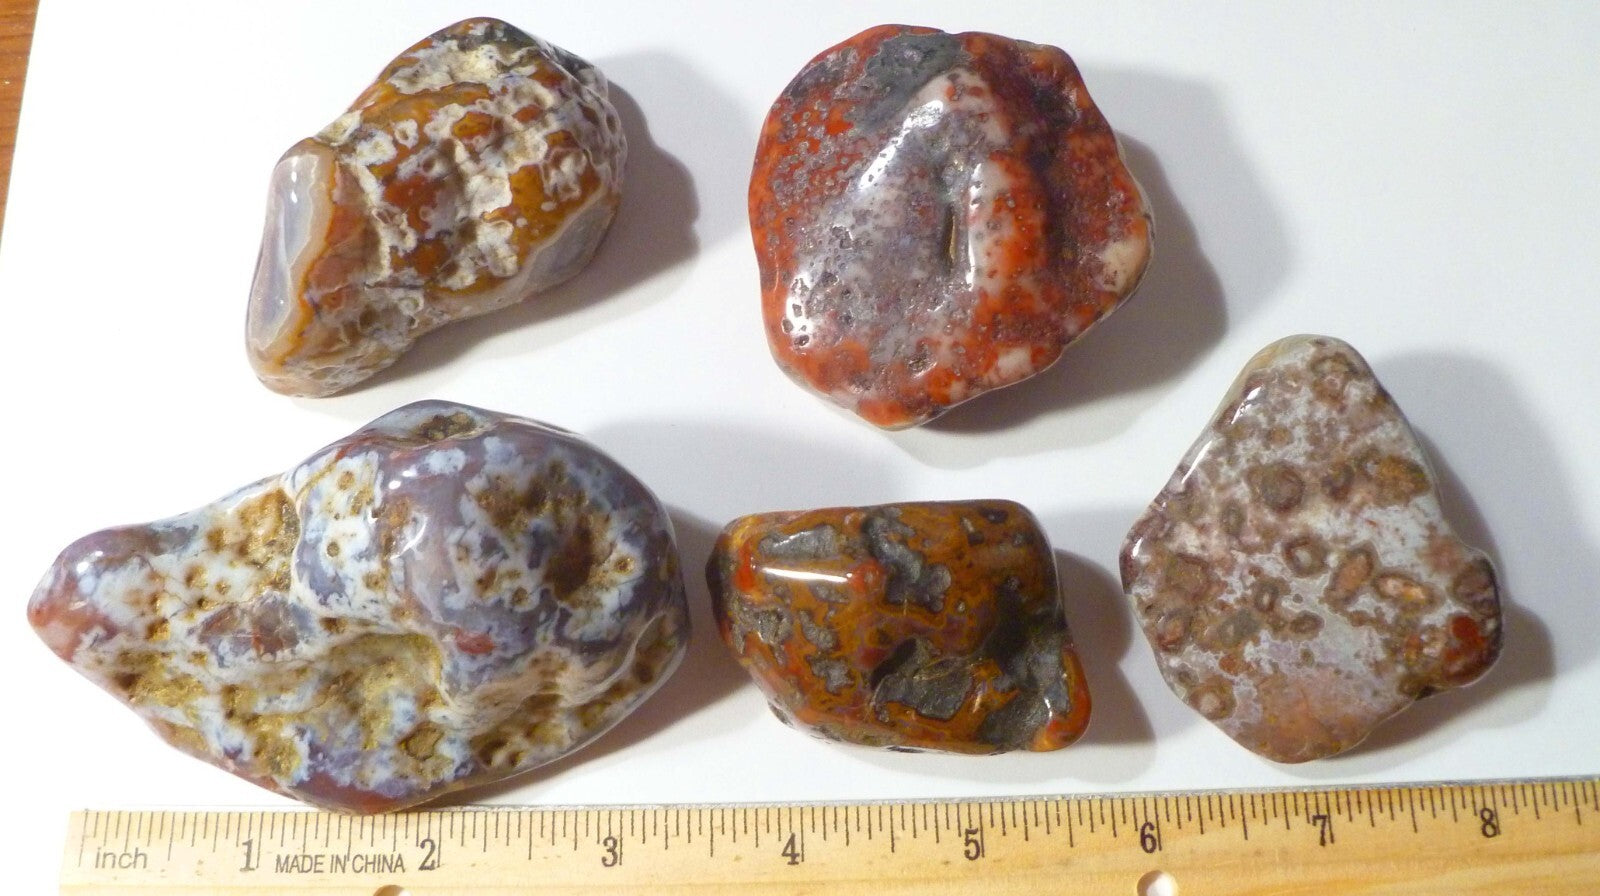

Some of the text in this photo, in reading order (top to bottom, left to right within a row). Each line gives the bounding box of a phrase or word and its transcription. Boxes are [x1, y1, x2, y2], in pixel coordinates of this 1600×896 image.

[1139, 820, 1157, 853] 6
[1310, 814, 1328, 847] 7
[1479, 807, 1497, 838] 8
[95, 847, 148, 869] inch
[239, 838, 256, 872] 1
[418, 838, 437, 871] 2
[601, 836, 618, 868] 3
[781, 833, 800, 866] 4
[963, 828, 980, 861] 5
[275, 853, 406, 874] MADE IN CHINA
